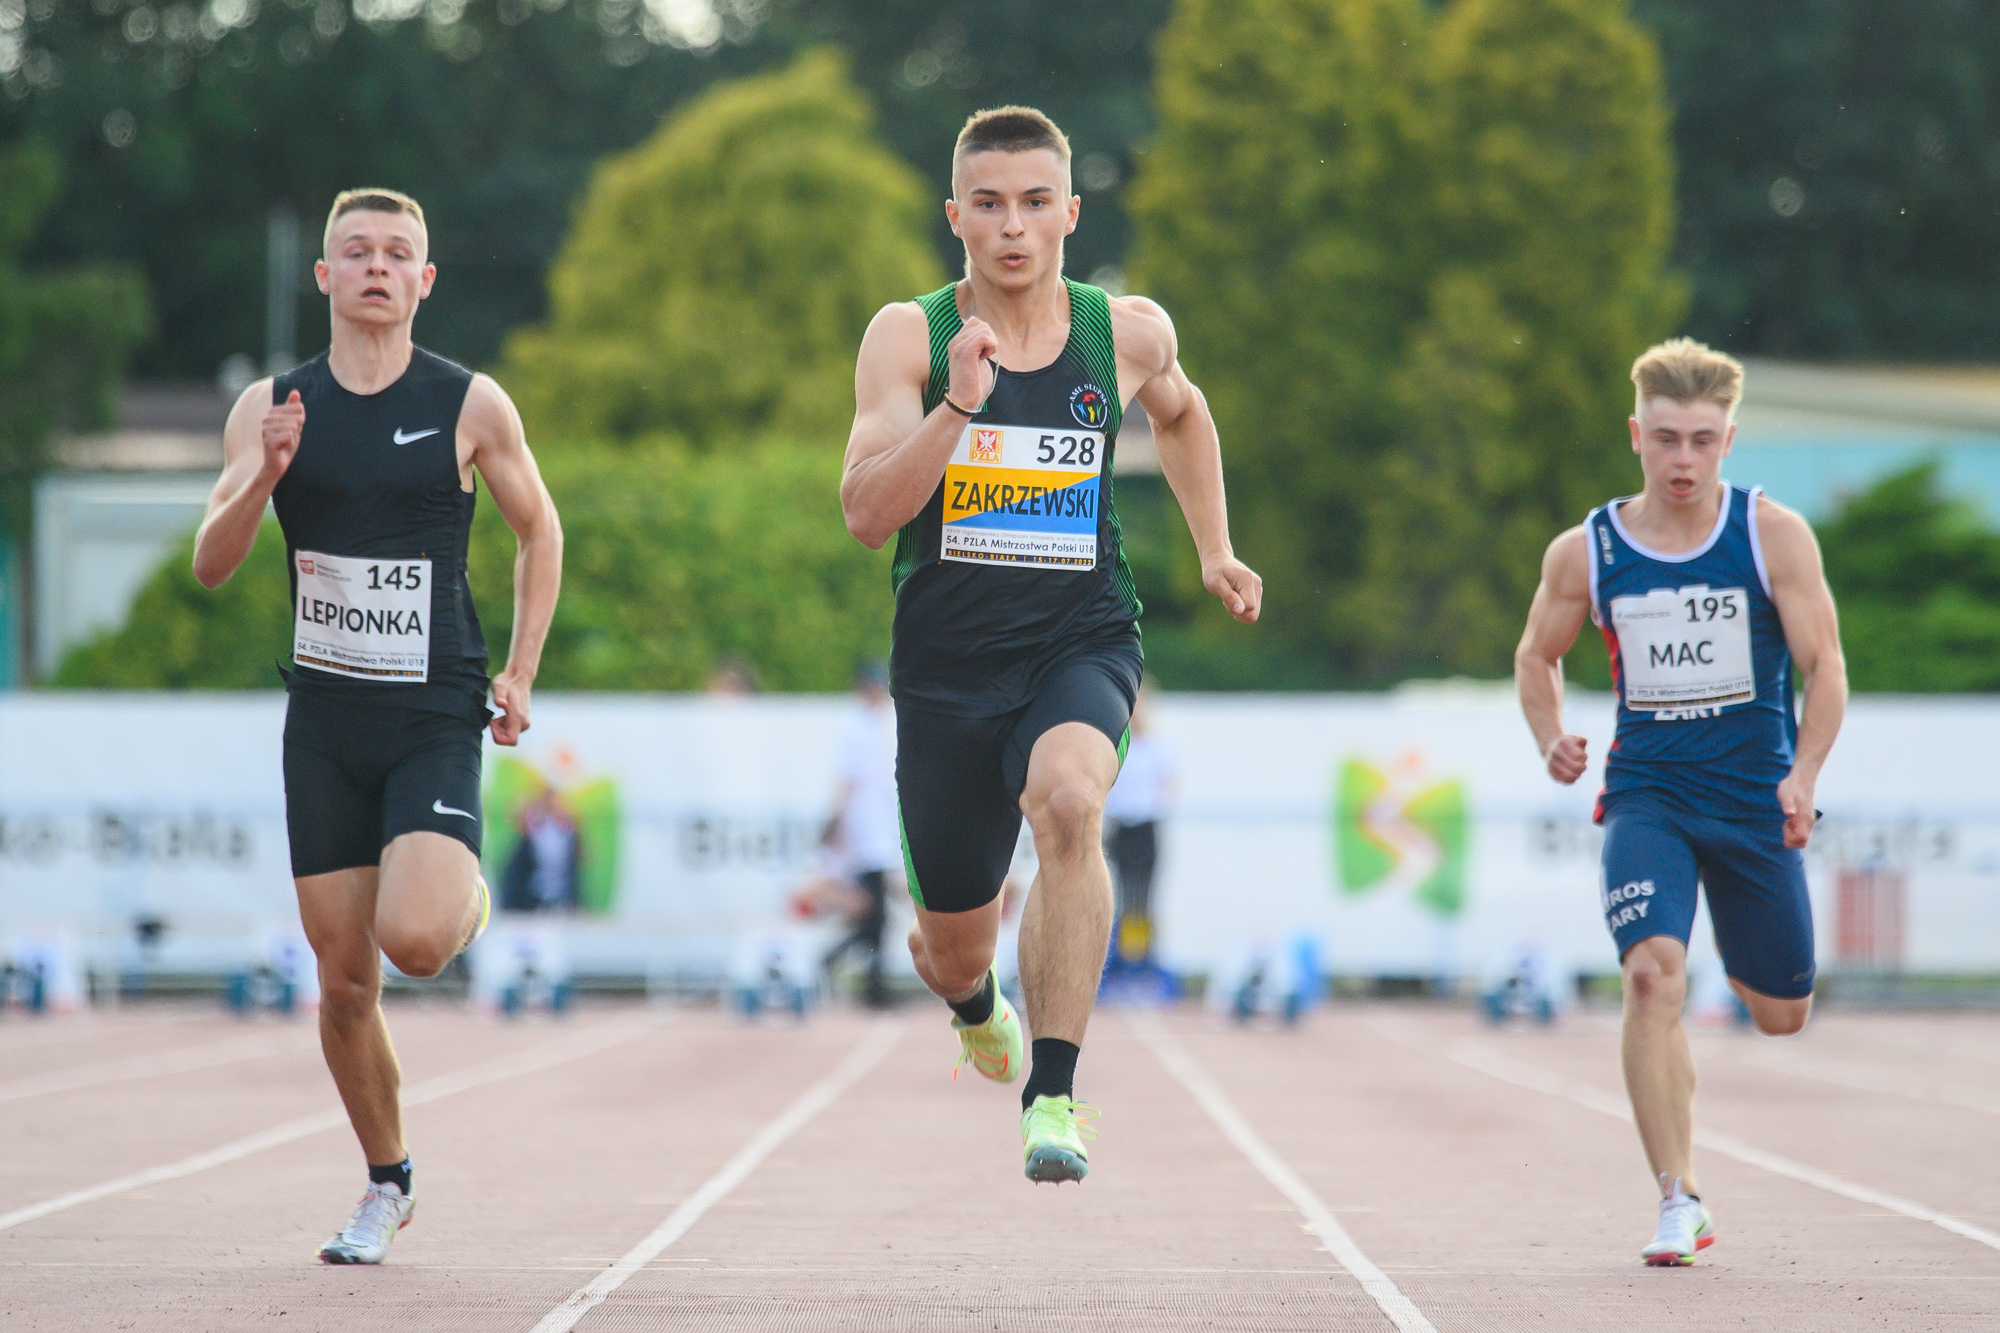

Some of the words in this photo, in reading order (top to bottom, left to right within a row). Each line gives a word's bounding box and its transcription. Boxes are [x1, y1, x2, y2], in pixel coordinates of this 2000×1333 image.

[970, 451, 1000, 463] PZLA
[1036, 434, 1096, 467] 528
[950, 480, 1095, 519] ZAKRZEWSKI
[945, 535, 960, 546] 54.
[963, 536, 988, 548] PZLA
[990, 538, 1049, 552] Mistrzostwa
[1051, 542, 1077, 553] Polski
[1079, 544, 1095, 554] U18
[947, 549, 1017, 562] BIELSKO-BIAŁA
[1032, 555, 1092, 566] 15-17.07.2022
[366, 564, 422, 591] 145
[301, 595, 424, 636] LEPIONKA
[1683, 594, 1738, 623] 195
[1650, 640, 1714, 669] MAC
[1604, 879, 1656, 913] ROS
[1606, 900, 1650, 933] ARY
